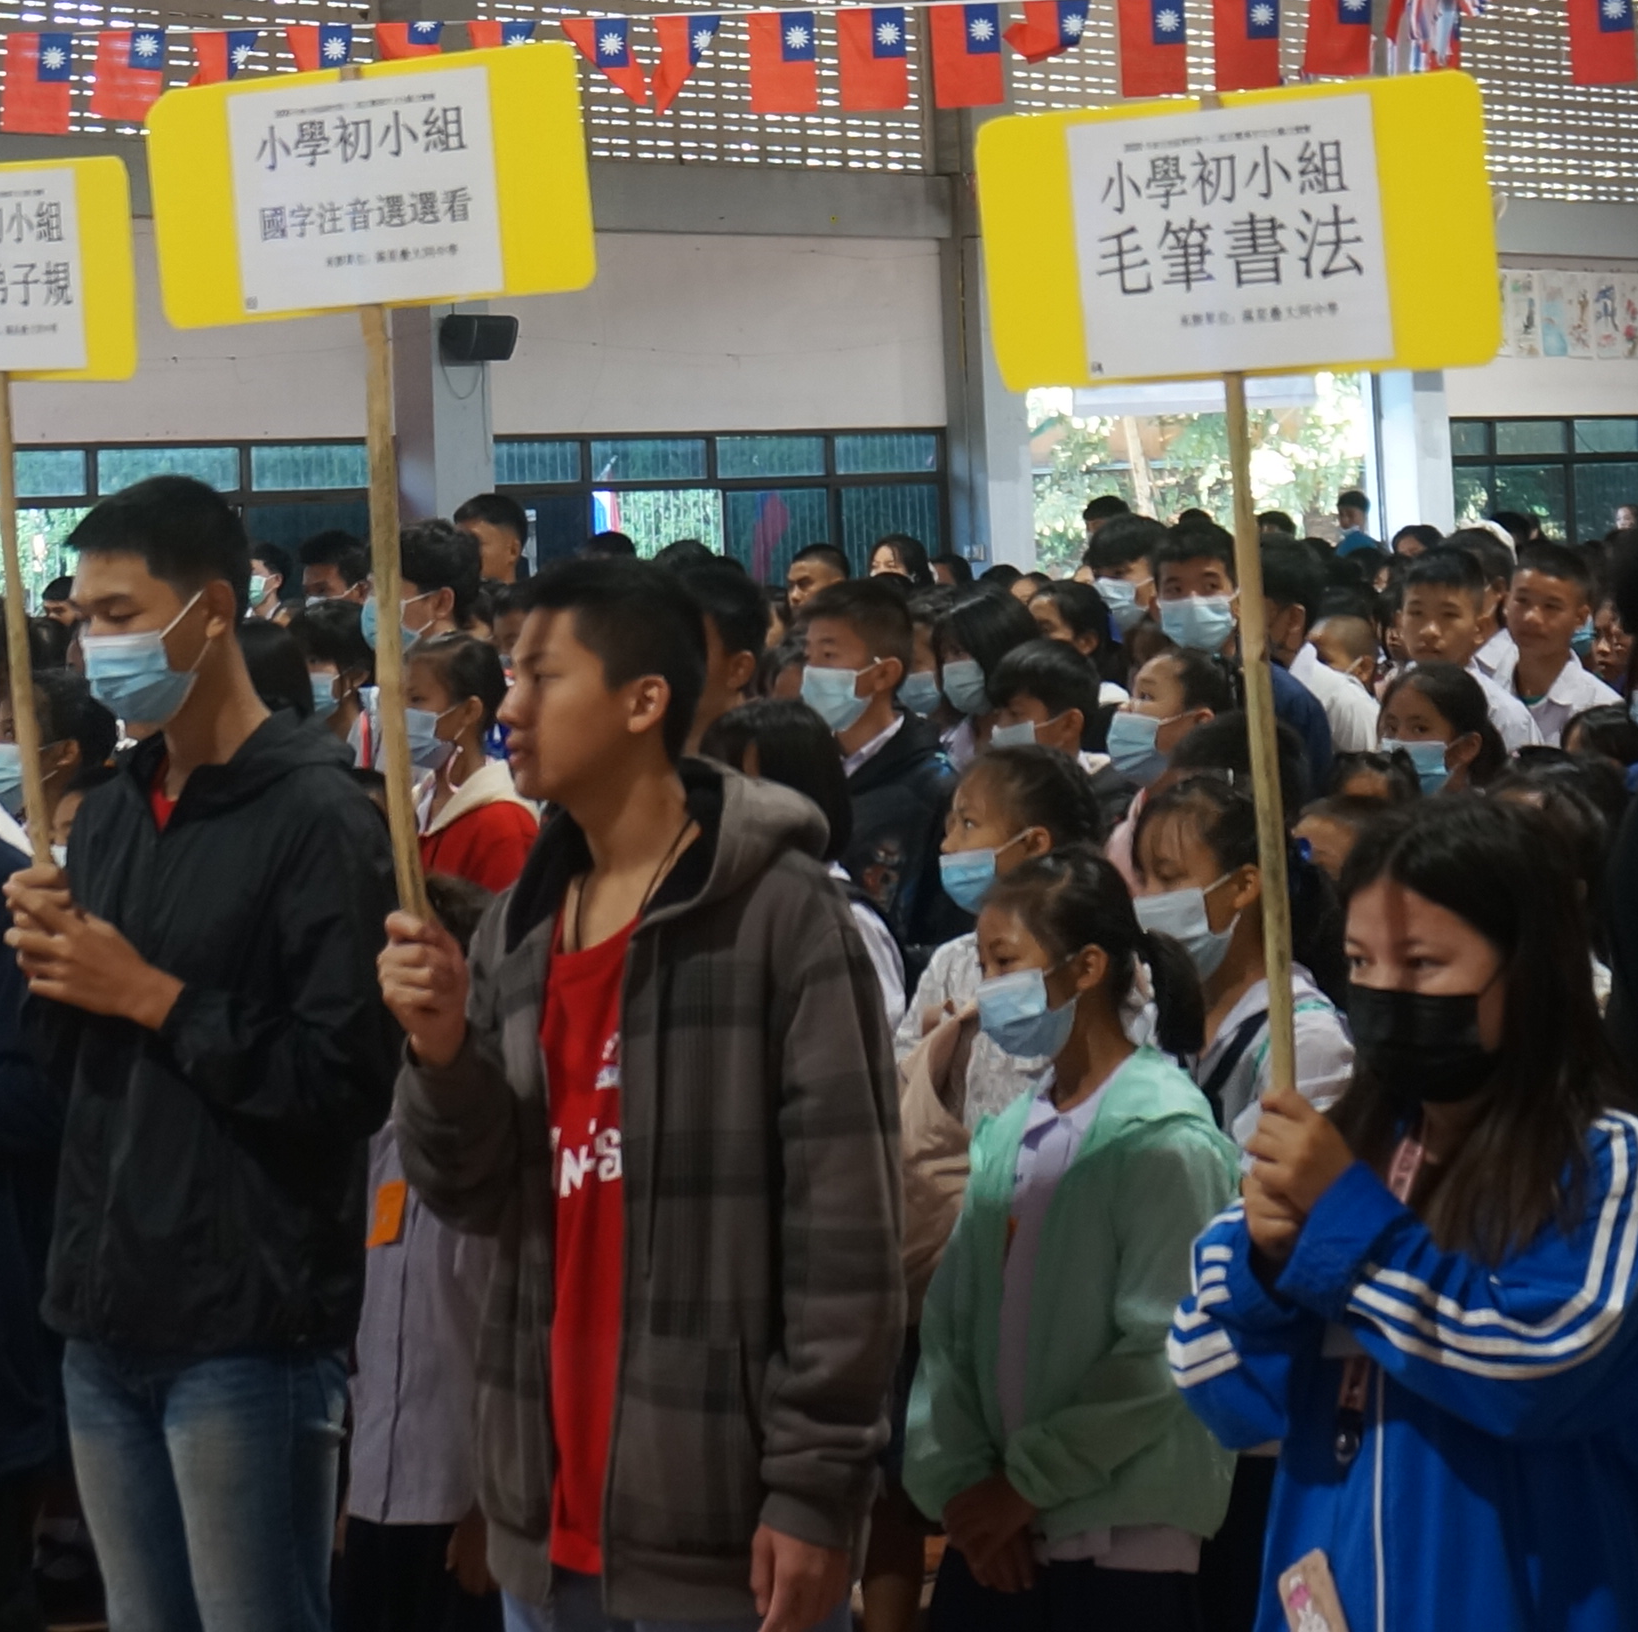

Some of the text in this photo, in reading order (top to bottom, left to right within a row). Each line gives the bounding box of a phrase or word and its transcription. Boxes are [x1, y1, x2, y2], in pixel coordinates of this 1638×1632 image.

[256, 104, 468, 171] 小學初小組
[1101, 139, 1350, 214] 小學初小組
[259, 186, 473, 243] 國字注音選選看
[1096, 203, 1364, 296] 毛筆書法
